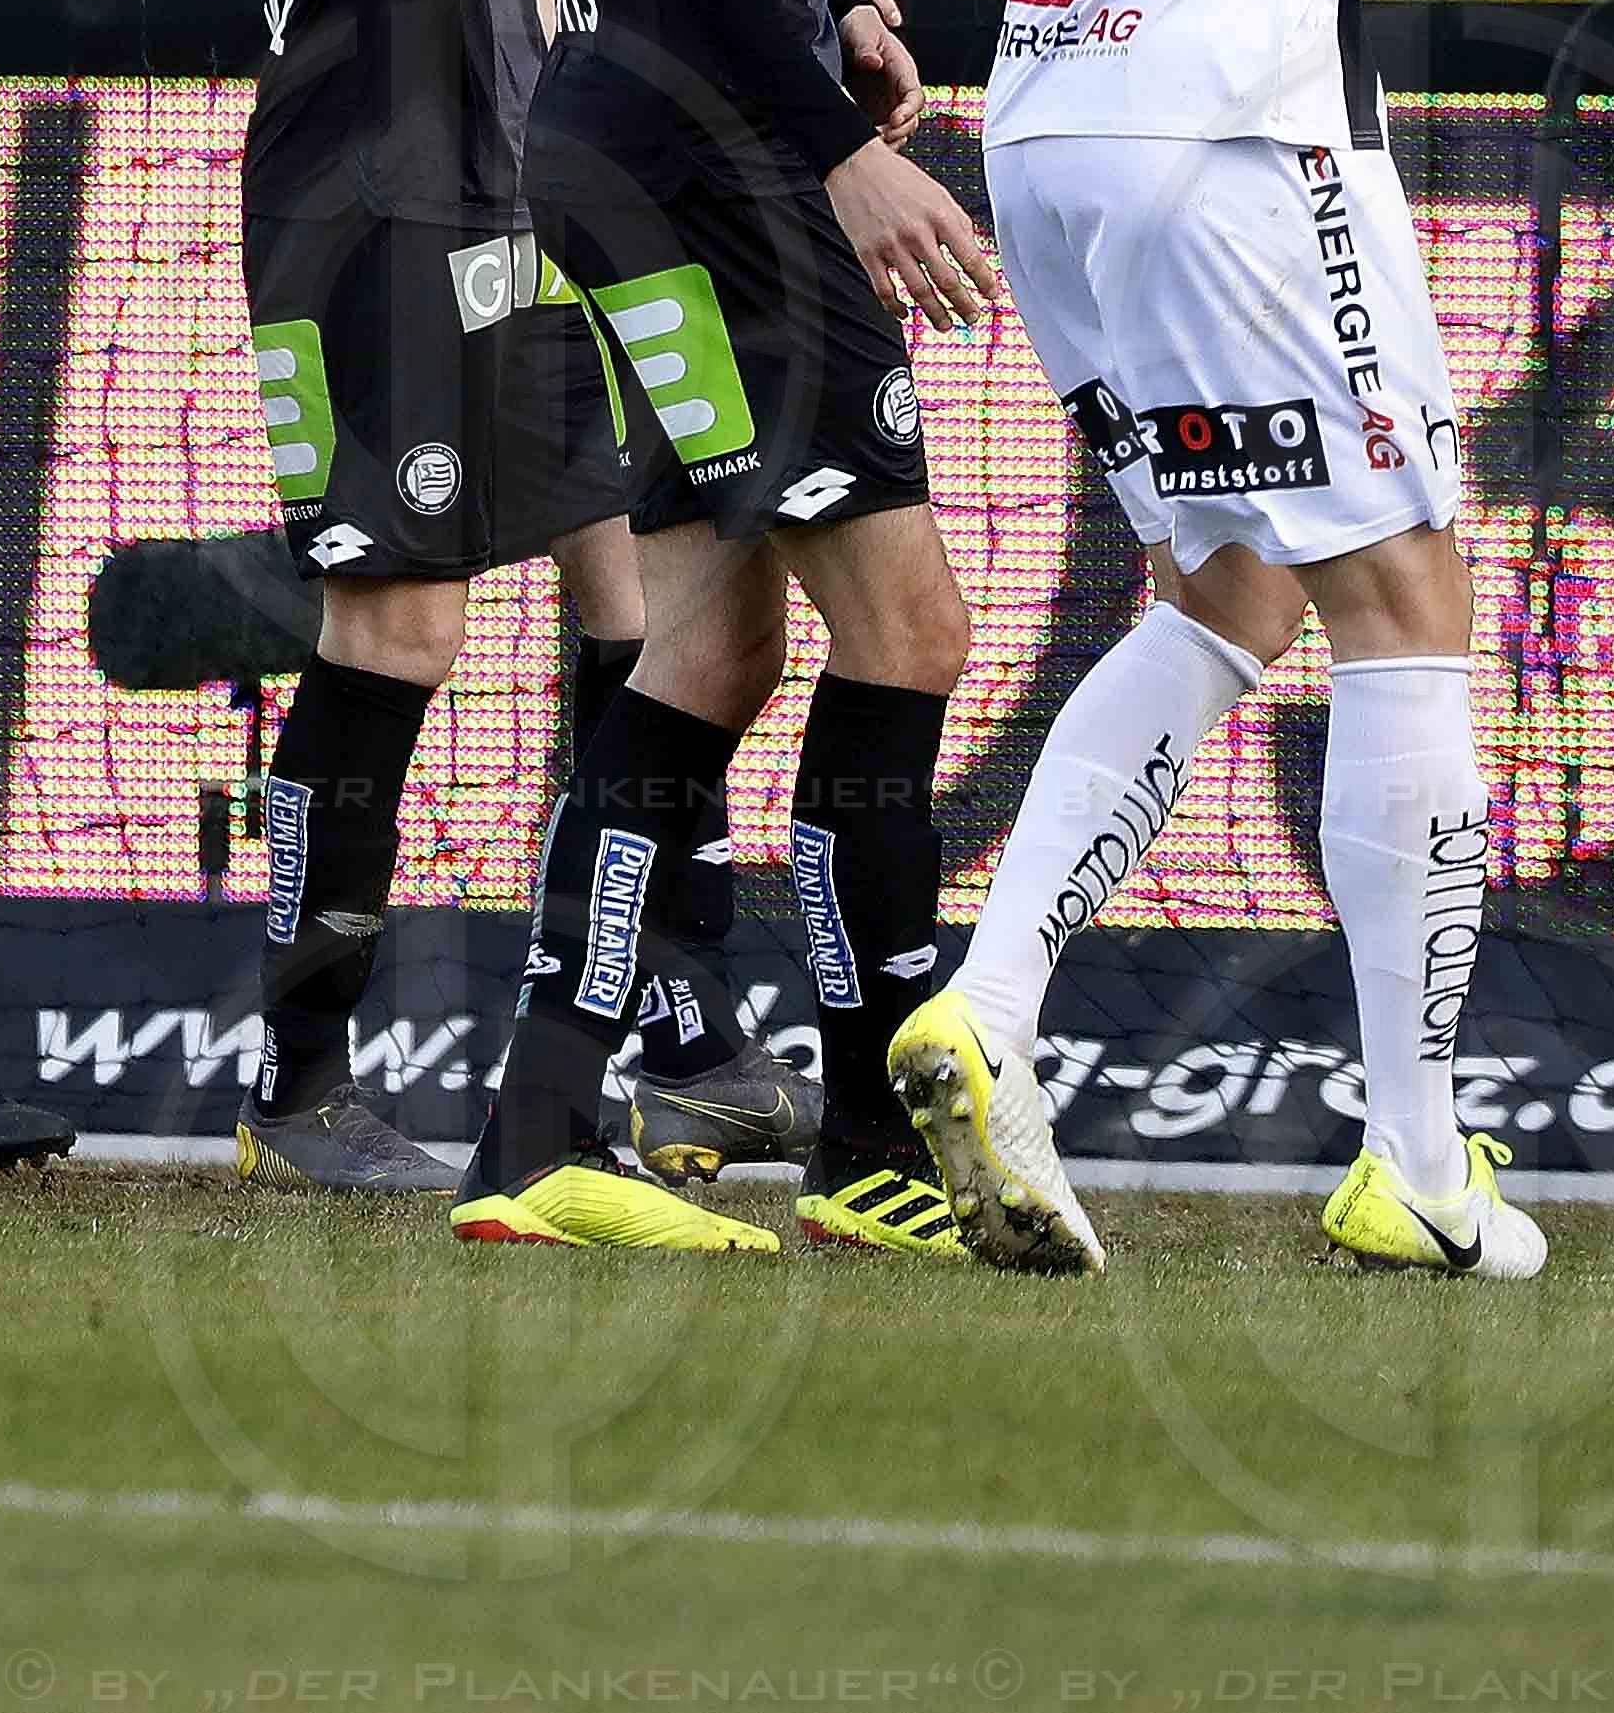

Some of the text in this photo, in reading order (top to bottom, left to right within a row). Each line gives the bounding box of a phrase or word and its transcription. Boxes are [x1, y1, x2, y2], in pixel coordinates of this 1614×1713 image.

[1081, 7, 1143, 45] AG
[1297, 145, 1407, 472] ENERGIE AG
[1424, 810, 1490, 920] LUCE
